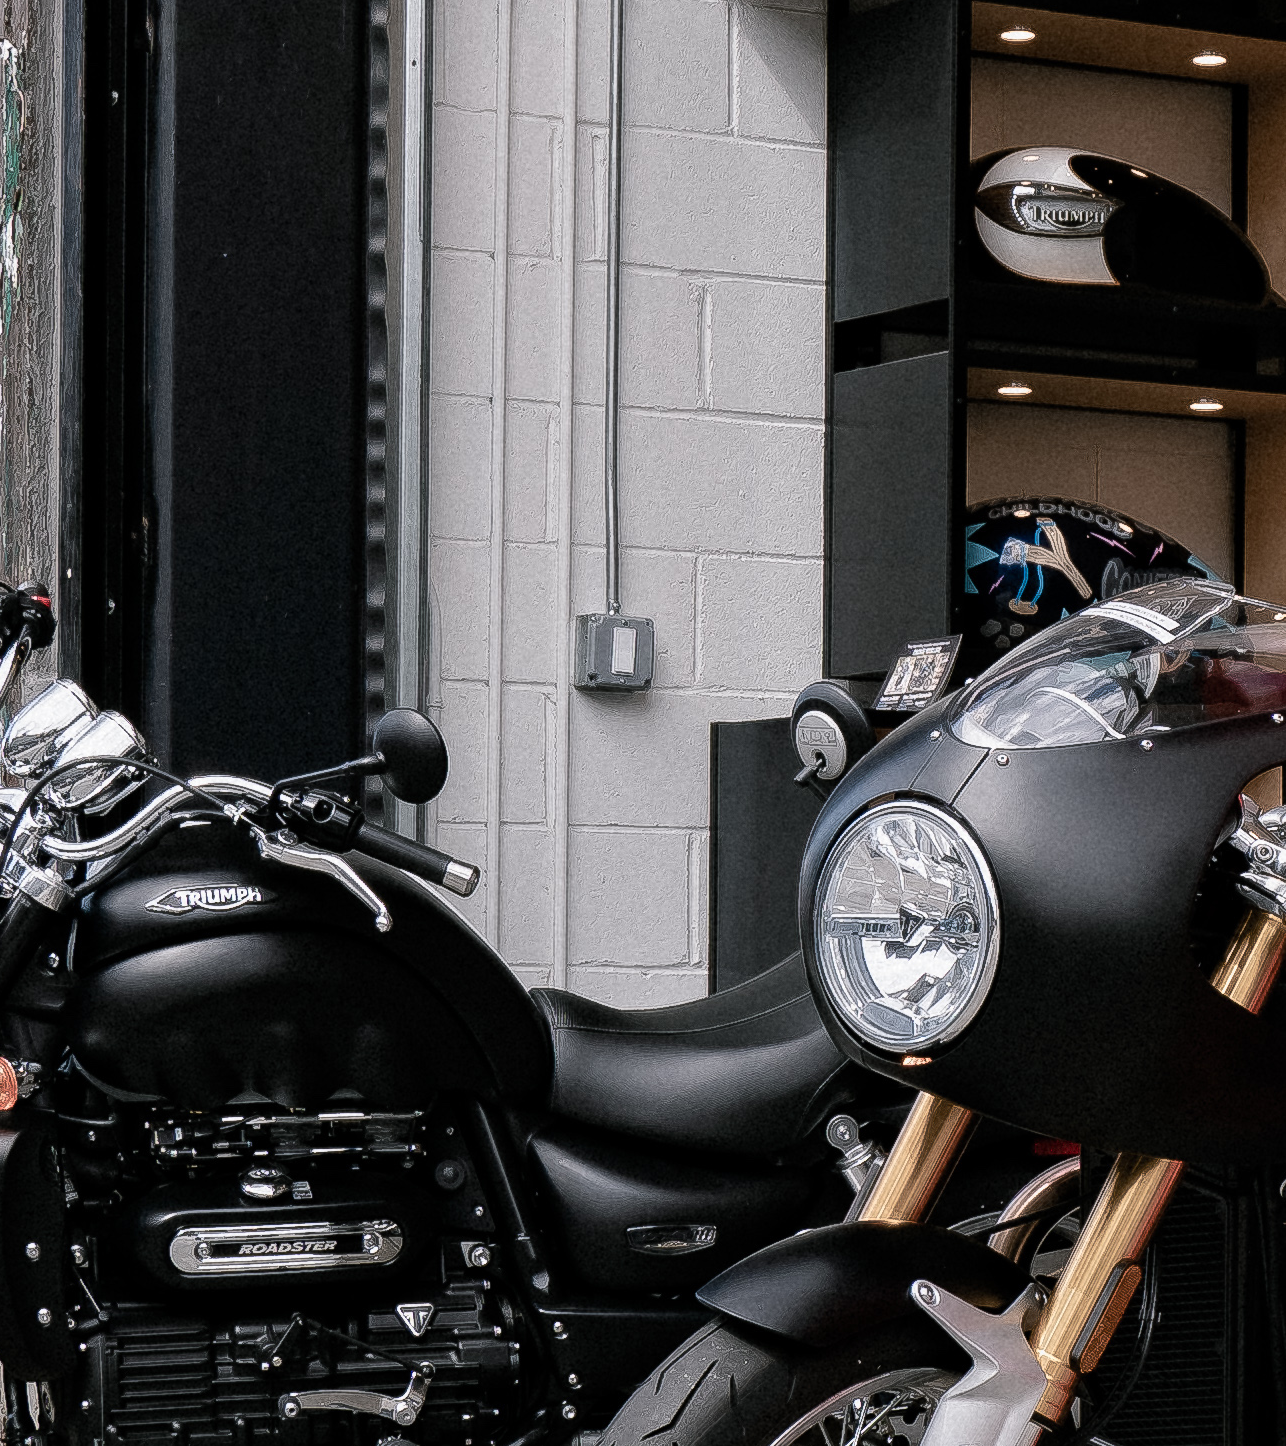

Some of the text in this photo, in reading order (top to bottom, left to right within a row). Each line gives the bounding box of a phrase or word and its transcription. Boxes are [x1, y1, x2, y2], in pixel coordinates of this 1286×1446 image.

[1028, 205, 1105, 224] TRIUMPH
[988, 502, 1135, 540] CHILDHOOD
[174, 887, 262, 908] TRIUMPH
[238, 1240, 338, 1255] ROADSTER
